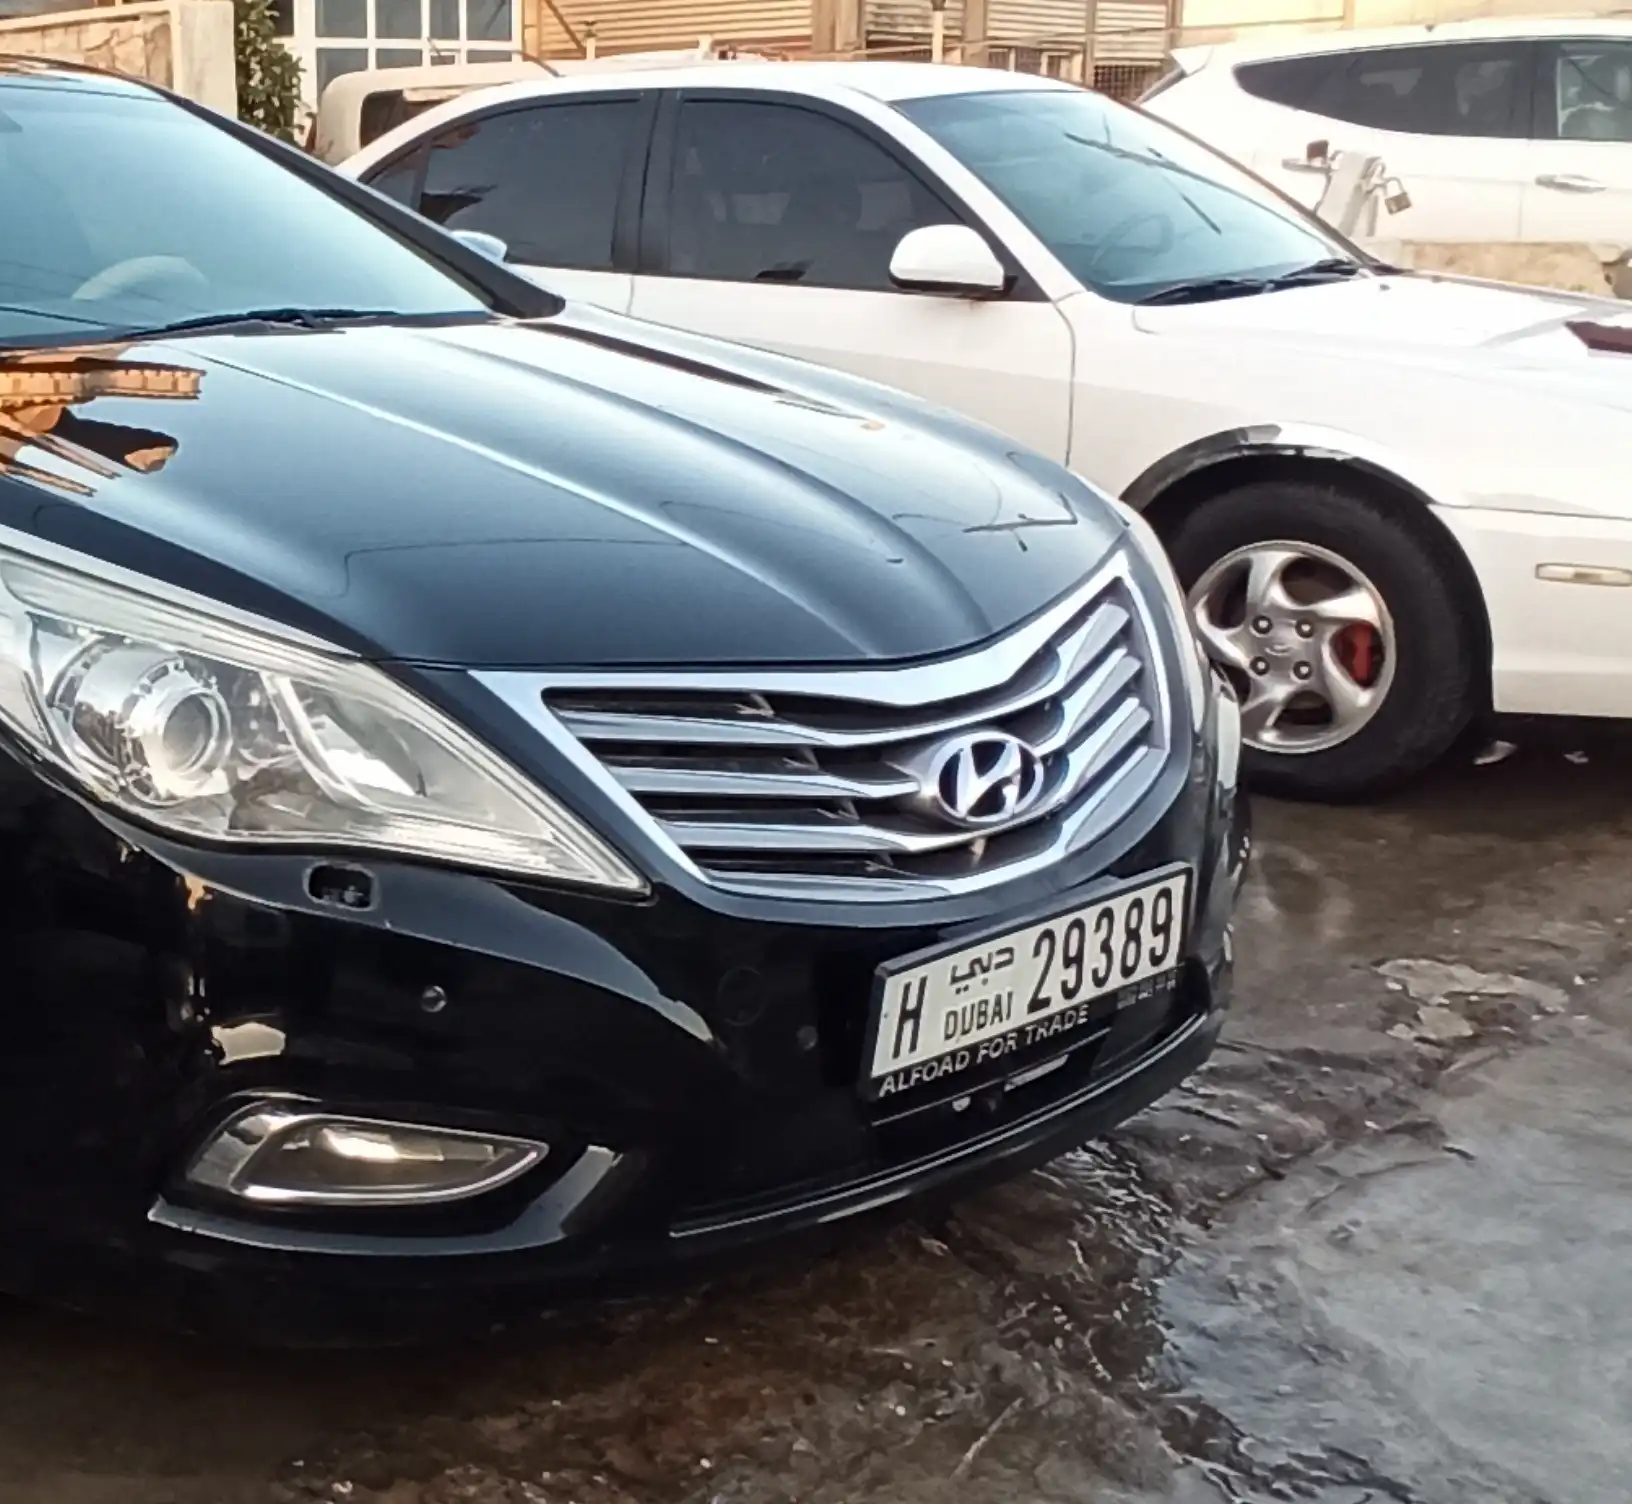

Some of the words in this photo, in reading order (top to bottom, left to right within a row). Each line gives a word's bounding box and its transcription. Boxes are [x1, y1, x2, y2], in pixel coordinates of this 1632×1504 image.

[892, 976, 928, 1060] H
[1027, 887, 1174, 1014] 29389
[950, 947, 1014, 995] دبي
[879, 1051, 970, 1097] ALFOAD
[976, 1032, 1019, 1064] FOR
[1025, 1003, 1090, 1045] TRADE
[943, 991, 1014, 1041] DUBAI
